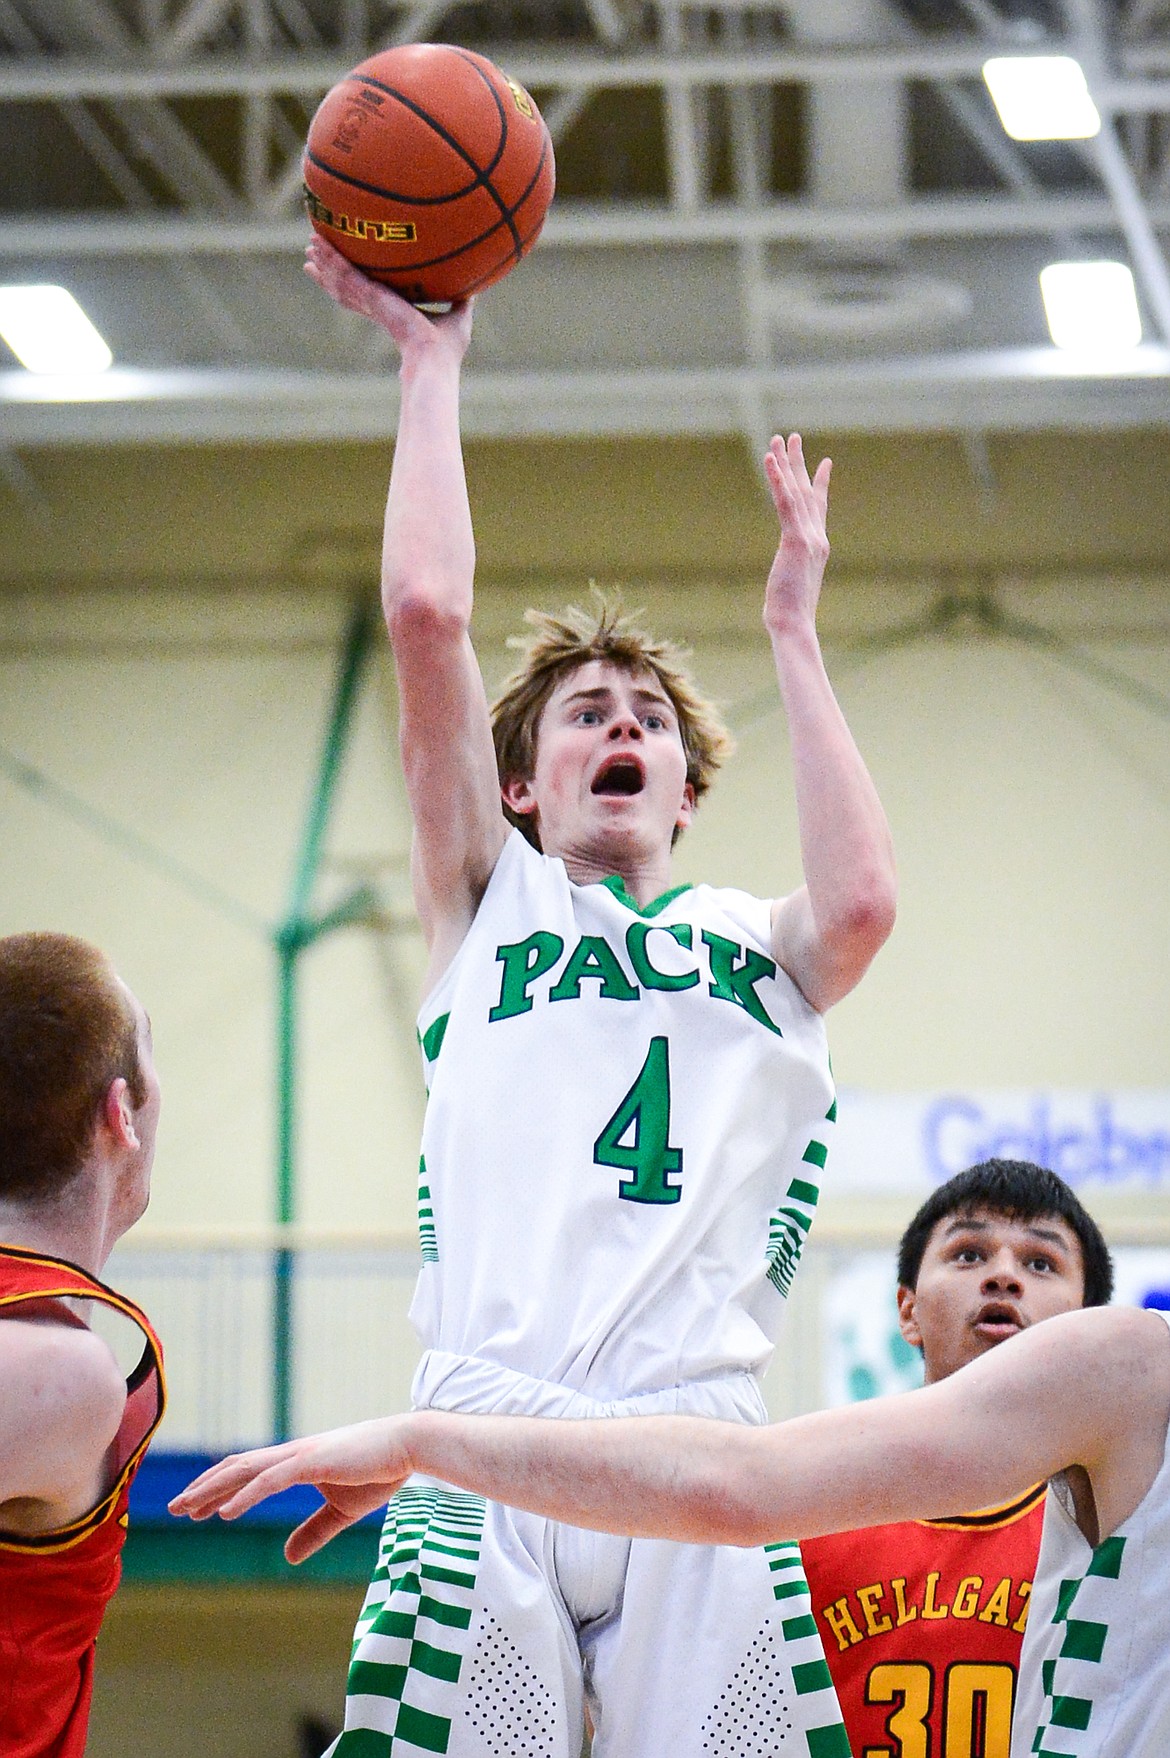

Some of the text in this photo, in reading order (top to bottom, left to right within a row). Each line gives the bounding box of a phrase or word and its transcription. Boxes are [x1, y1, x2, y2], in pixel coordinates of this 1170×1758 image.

[489, 922, 783, 1038] PACK
[593, 1035, 683, 1204] 4
[823, 1571, 1033, 1652] HELLGAT
[862, 1660, 1018, 1758] 30
